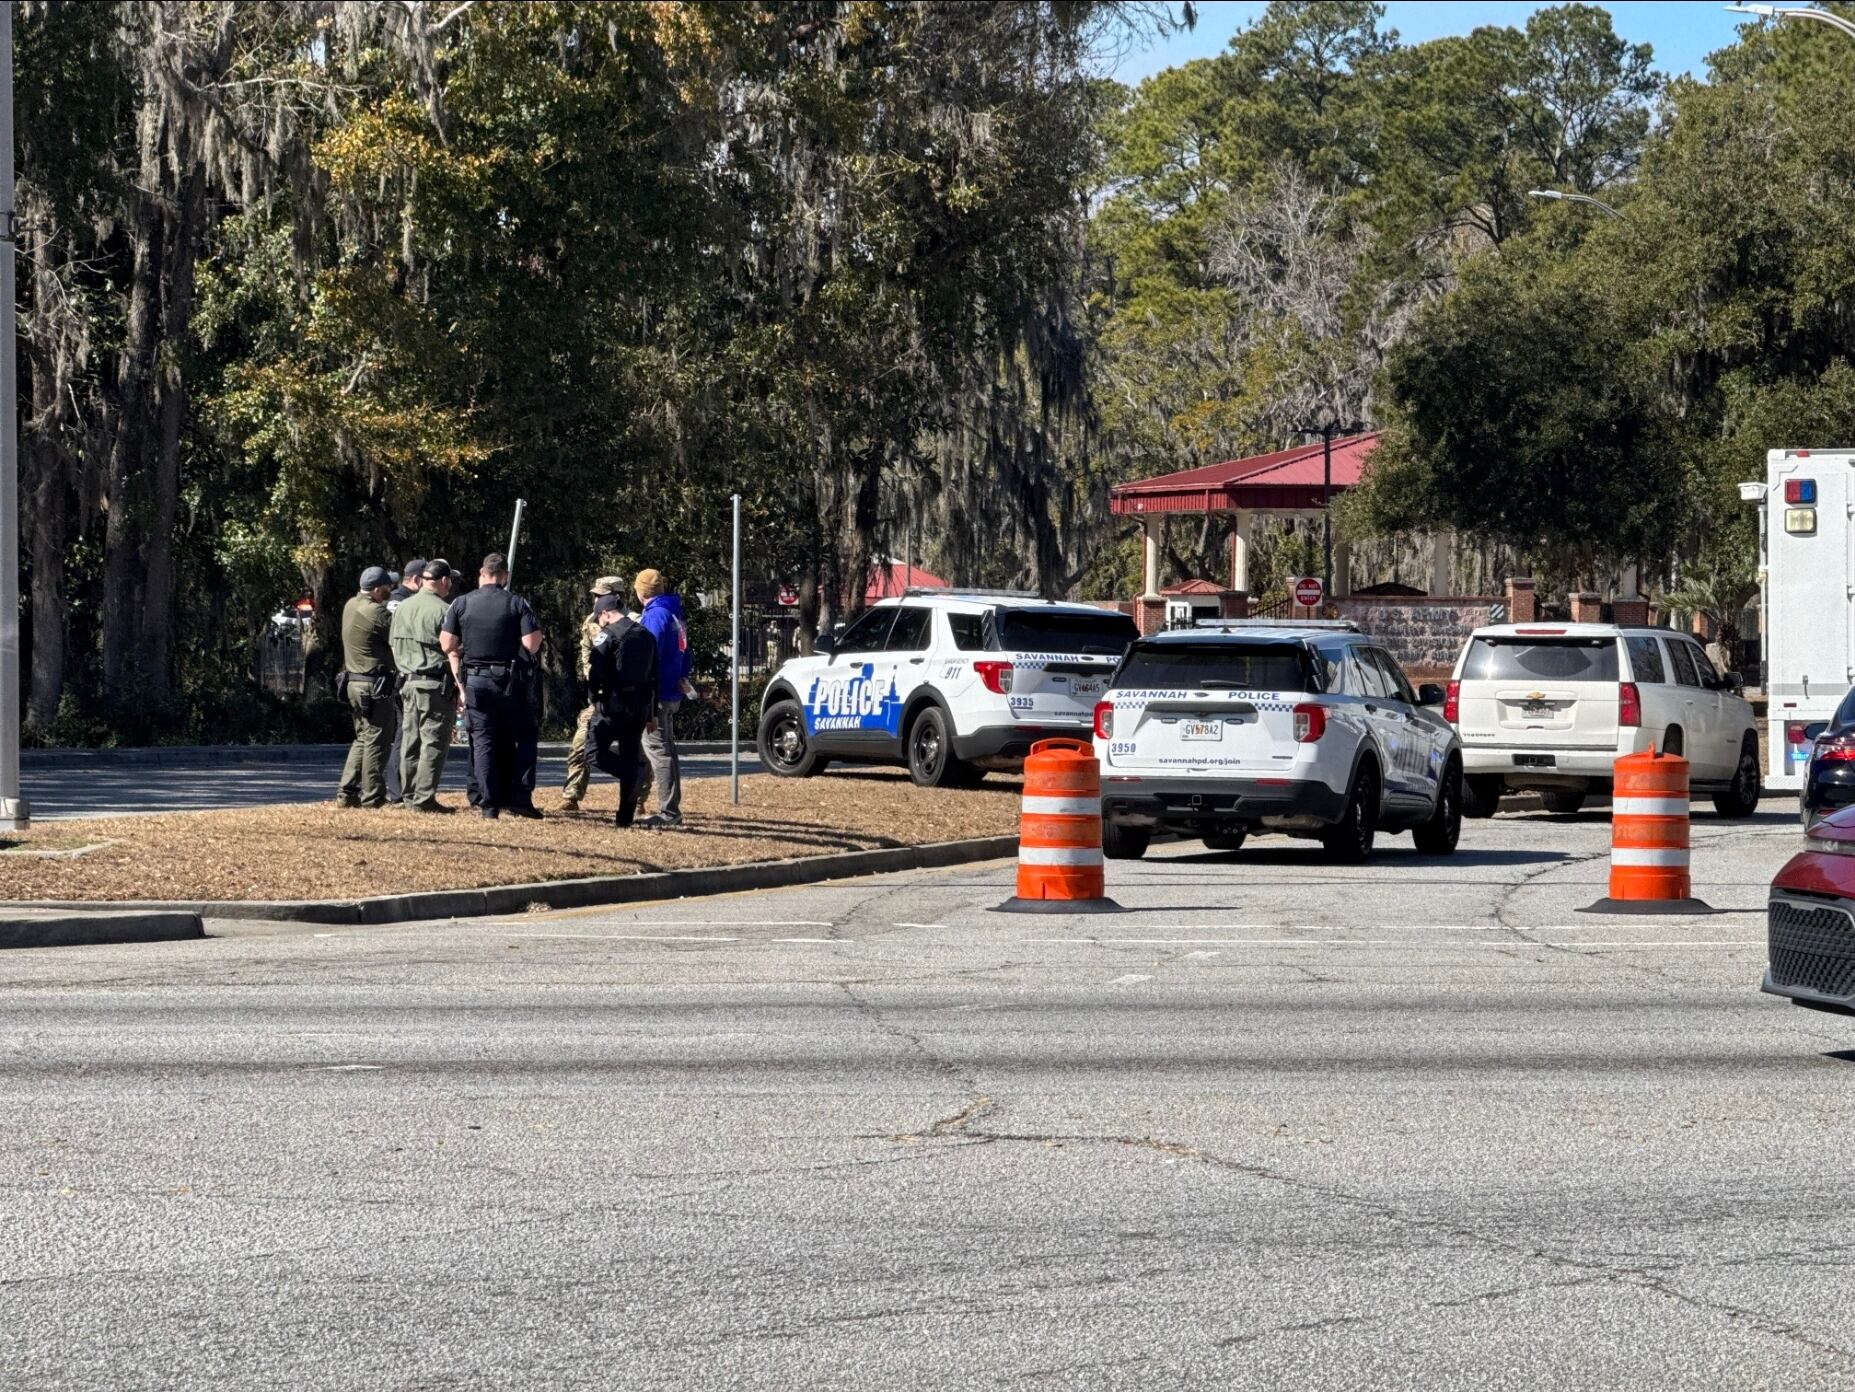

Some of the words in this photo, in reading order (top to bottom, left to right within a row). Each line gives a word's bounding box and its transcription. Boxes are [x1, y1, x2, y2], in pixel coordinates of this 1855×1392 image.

[1016, 653, 1079, 662] SAVANNAH
[944, 666, 962, 679] 911
[813, 679, 885, 716] POLICE
[1116, 690, 1187, 699] SAVANNAH
[1228, 691, 1281, 700] POLICE
[1010, 697, 1034, 706] 3935
[814, 716, 861, 730] SAVANNAH
[1111, 743, 1136, 753] 3950
